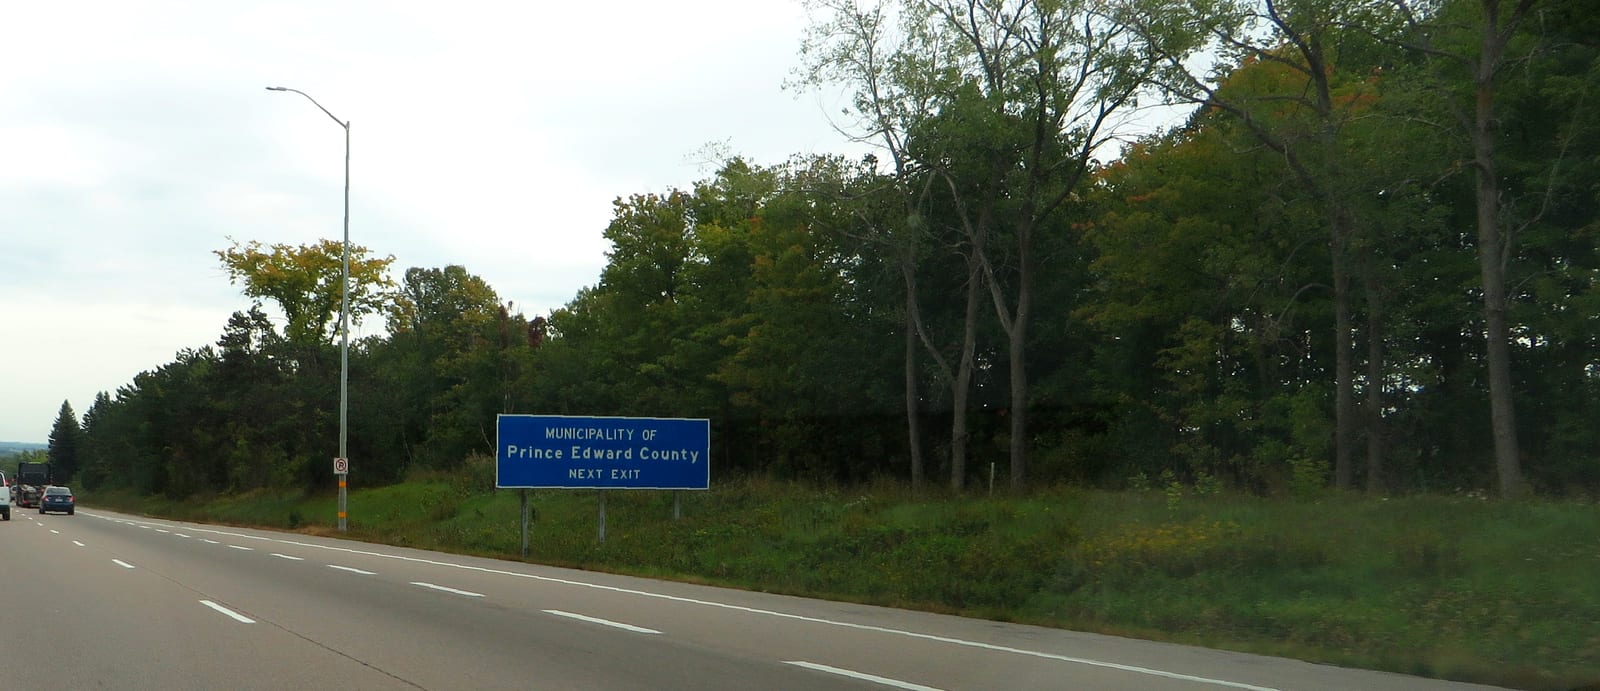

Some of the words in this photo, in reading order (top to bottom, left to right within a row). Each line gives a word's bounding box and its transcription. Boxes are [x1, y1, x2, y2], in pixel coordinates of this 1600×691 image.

[545, 427, 635, 441] MUNICIPALITY
[642, 429, 657, 441] OF
[507, 445, 563, 459] Prince
[571, 446, 633, 460] Edward
[639, 447, 699, 464] County
[569, 469, 603, 479] NEXT
[611, 469, 641, 480] EXIT
